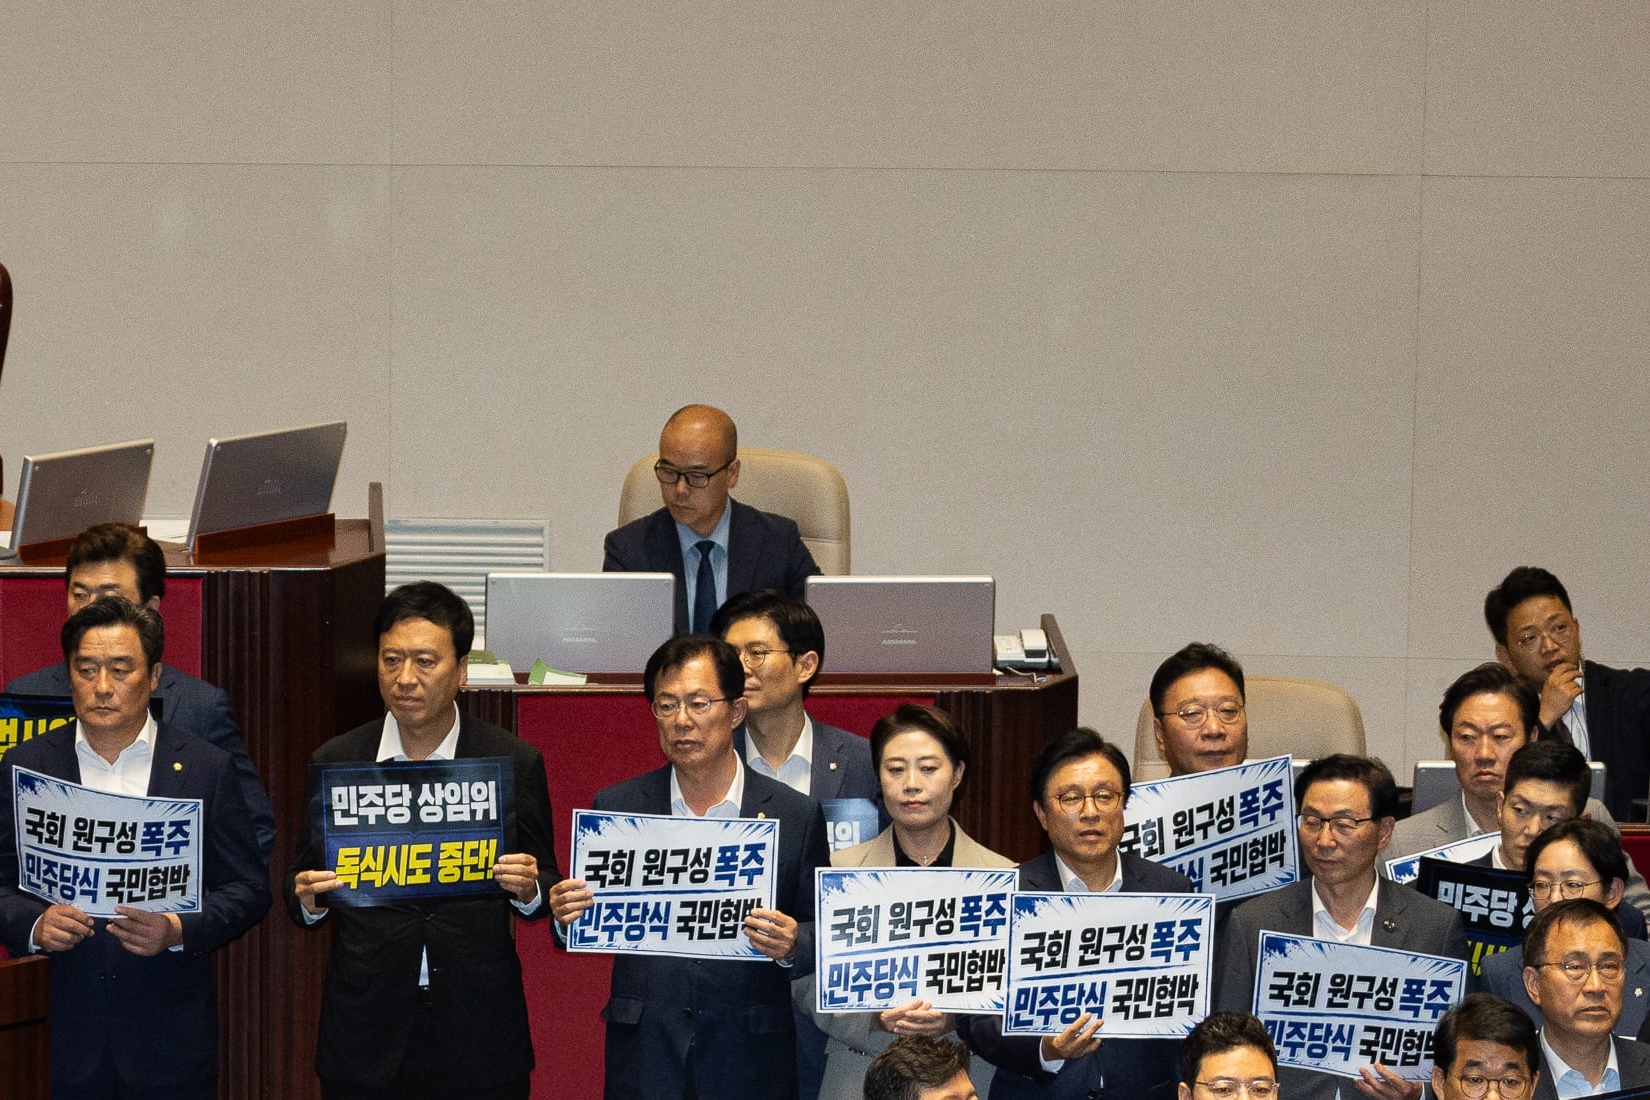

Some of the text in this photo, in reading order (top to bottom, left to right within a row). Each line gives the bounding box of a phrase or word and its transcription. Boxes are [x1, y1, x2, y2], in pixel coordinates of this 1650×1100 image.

[331, 780, 497, 826] 민주당 상임위
[1121, 779, 1284, 859] 국회 원구성 폭주
[25, 806, 191, 857] 국회 원구성 폭주
[23, 854, 191, 904] 민주당식 국민협박
[335, 838, 498, 890] 독식시도 중단!
[584, 842, 767, 888] 국회 원구성 폭주
[1209, 829, 1287, 887] 국민협박
[577, 901, 670, 944] 민주당식
[830, 892, 1007, 947] 국회 원구성 폭주
[1437, 881, 1518, 927] 민주당
[1019, 918, 1202, 972] 국회 원구성 폭주
[827, 948, 1005, 1003] 민주당식 국민협박
[1014, 974, 1199, 1028] 민주당식 국민협박
[1268, 971, 1453, 1022] 국회 원구성 폭주
[1264, 1020, 1354, 1061] 민주당식
